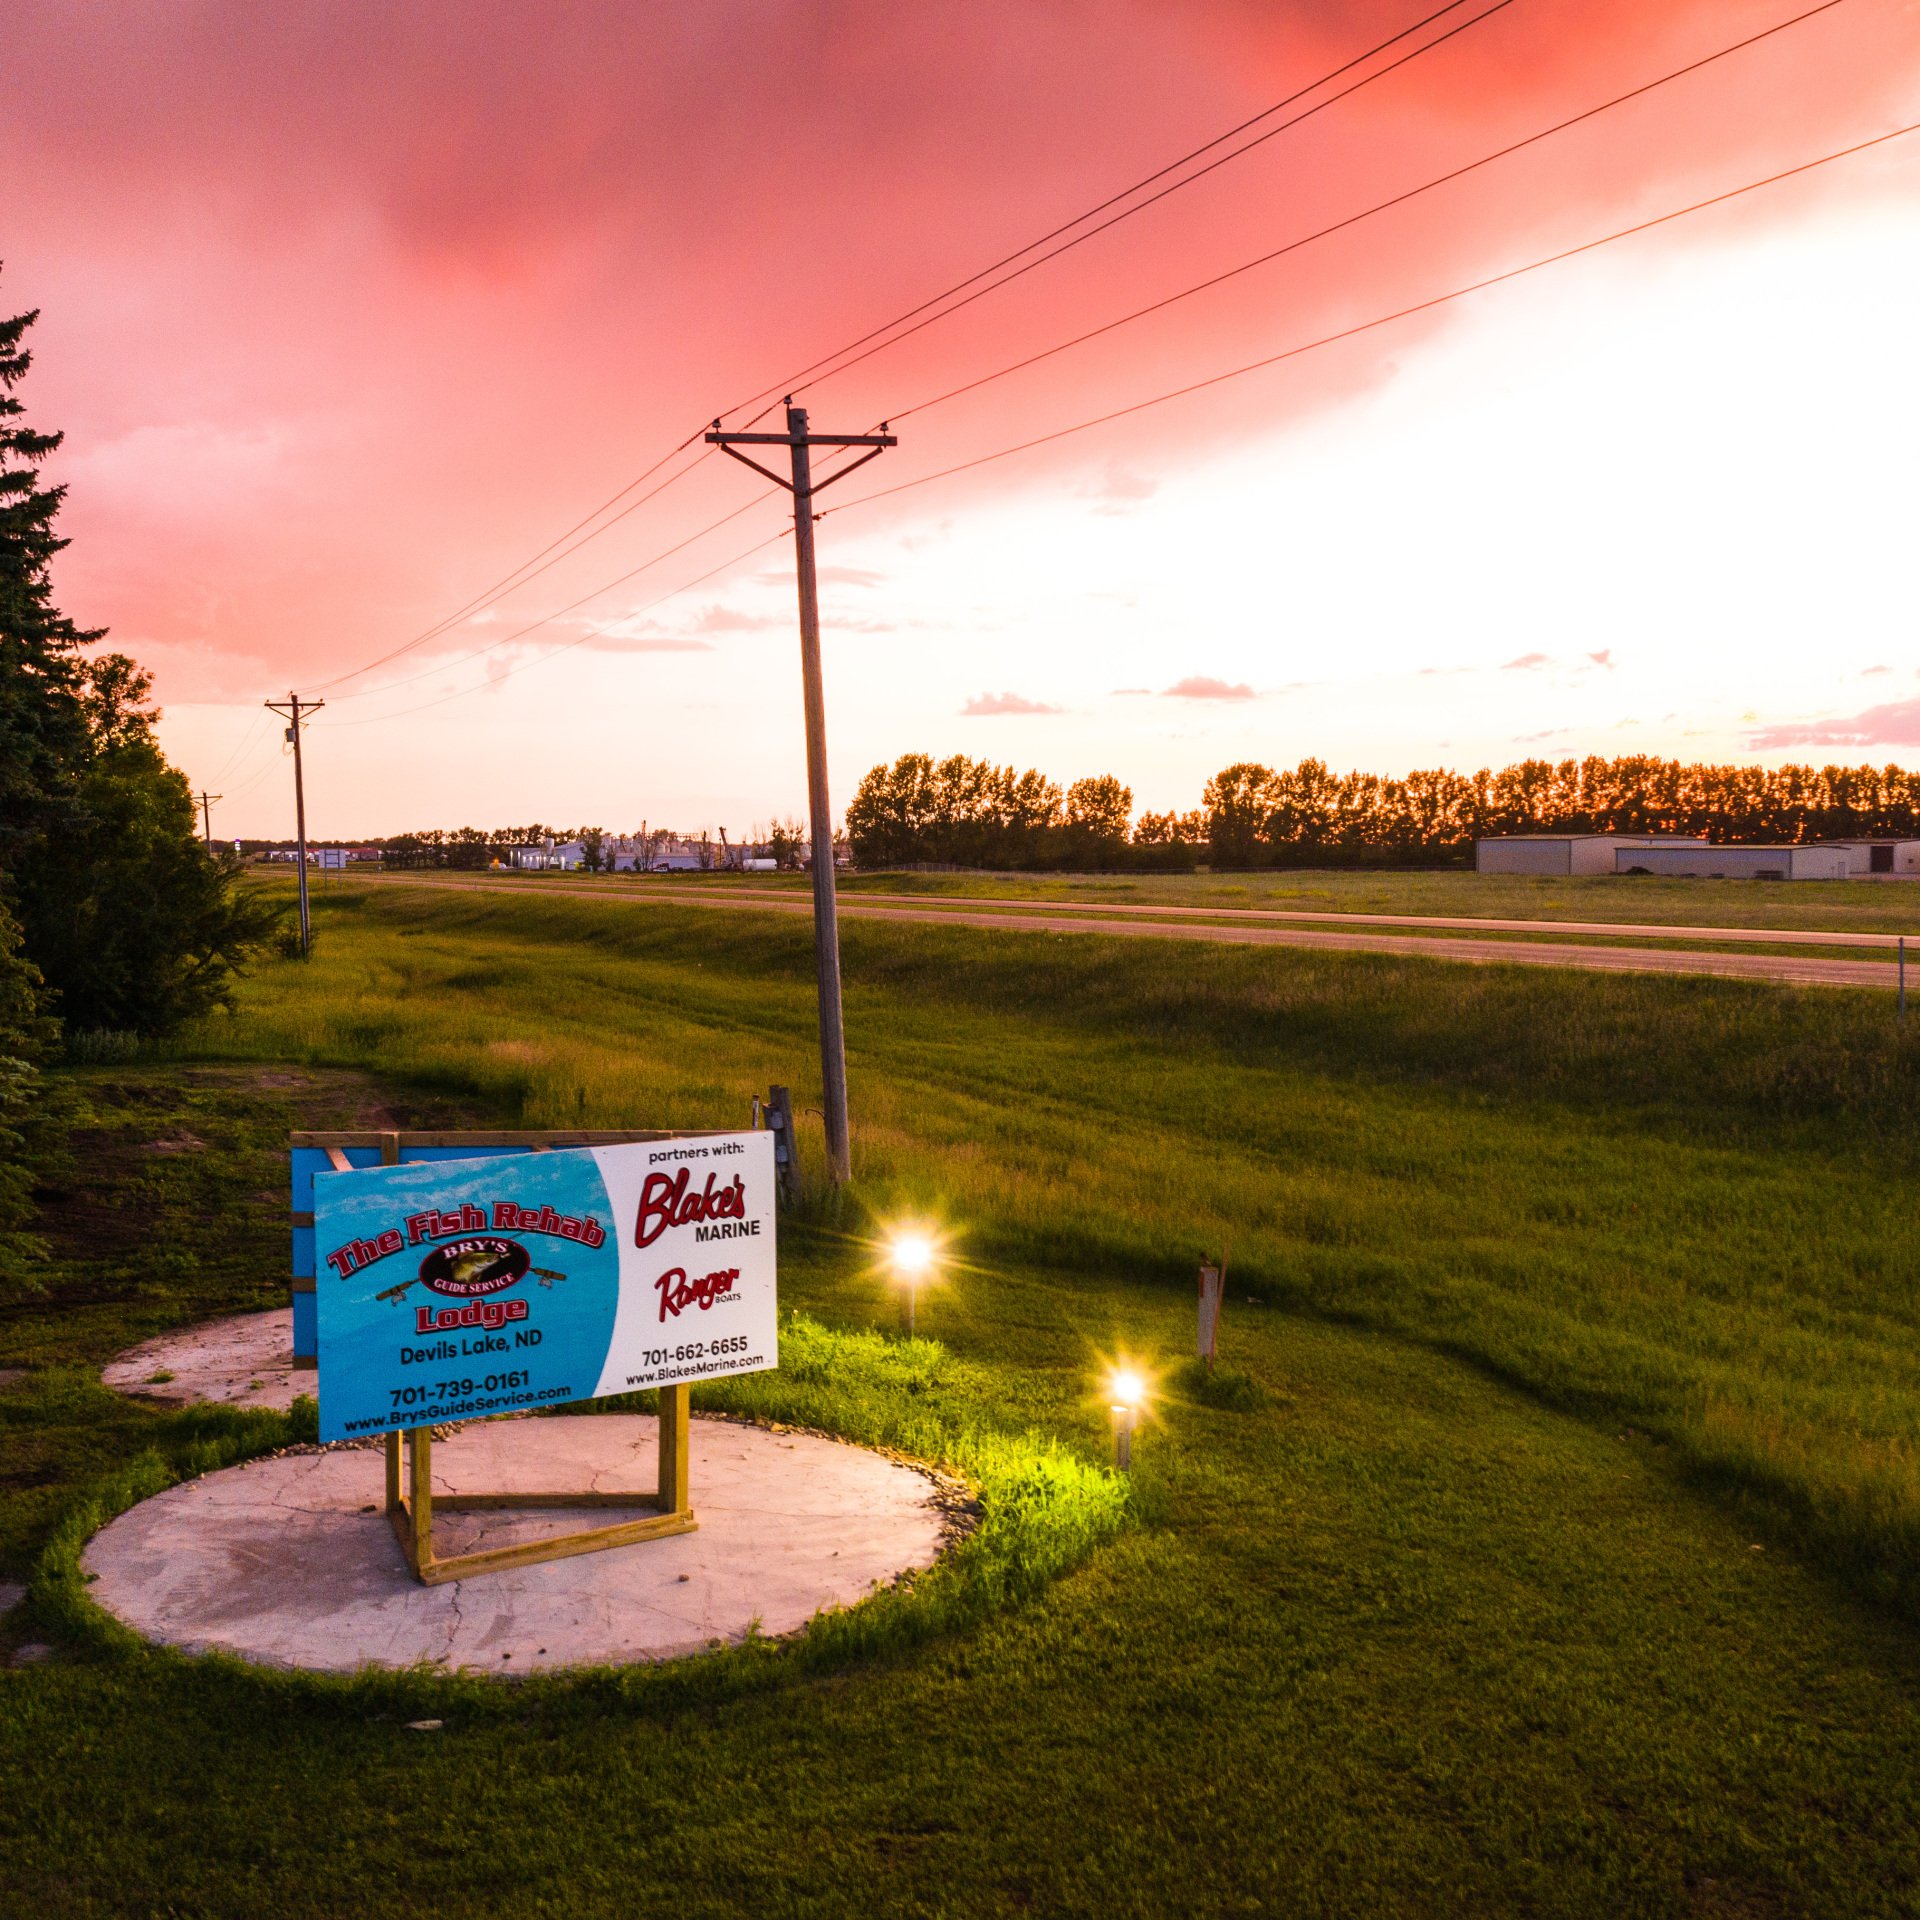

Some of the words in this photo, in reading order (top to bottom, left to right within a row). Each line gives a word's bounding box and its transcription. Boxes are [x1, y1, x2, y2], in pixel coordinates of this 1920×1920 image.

[649, 1147, 709, 1165] partners
[712, 1142, 745, 1156] with:
[634, 1167, 746, 1249] Blake's
[327, 1228, 404, 1280] The
[404, 1203, 487, 1247] Fish
[491, 1201, 606, 1249] Rehab
[695, 1220, 761, 1243] MARINE
[443, 1240, 509, 1259] BRY'S
[433, 1278, 468, 1293] GUIDE
[469, 1272, 515, 1293] SERVICE
[654, 1267, 740, 1323] Ranger
[715, 1293, 742, 1304] BOATS
[415, 1299, 529, 1335] Lodge
[400, 1340, 457, 1365] Devils
[461, 1334, 511, 1356] Lake,
[515, 1328, 543, 1348] ND
[642, 1336, 748, 1367] 701-662-6655
[626, 1354, 764, 1385] www.BlakesMarine.com
[390, 1370, 529, 1408] 701-739-0161
[344, 1385, 572, 1432] www.BrysGuideService.com
